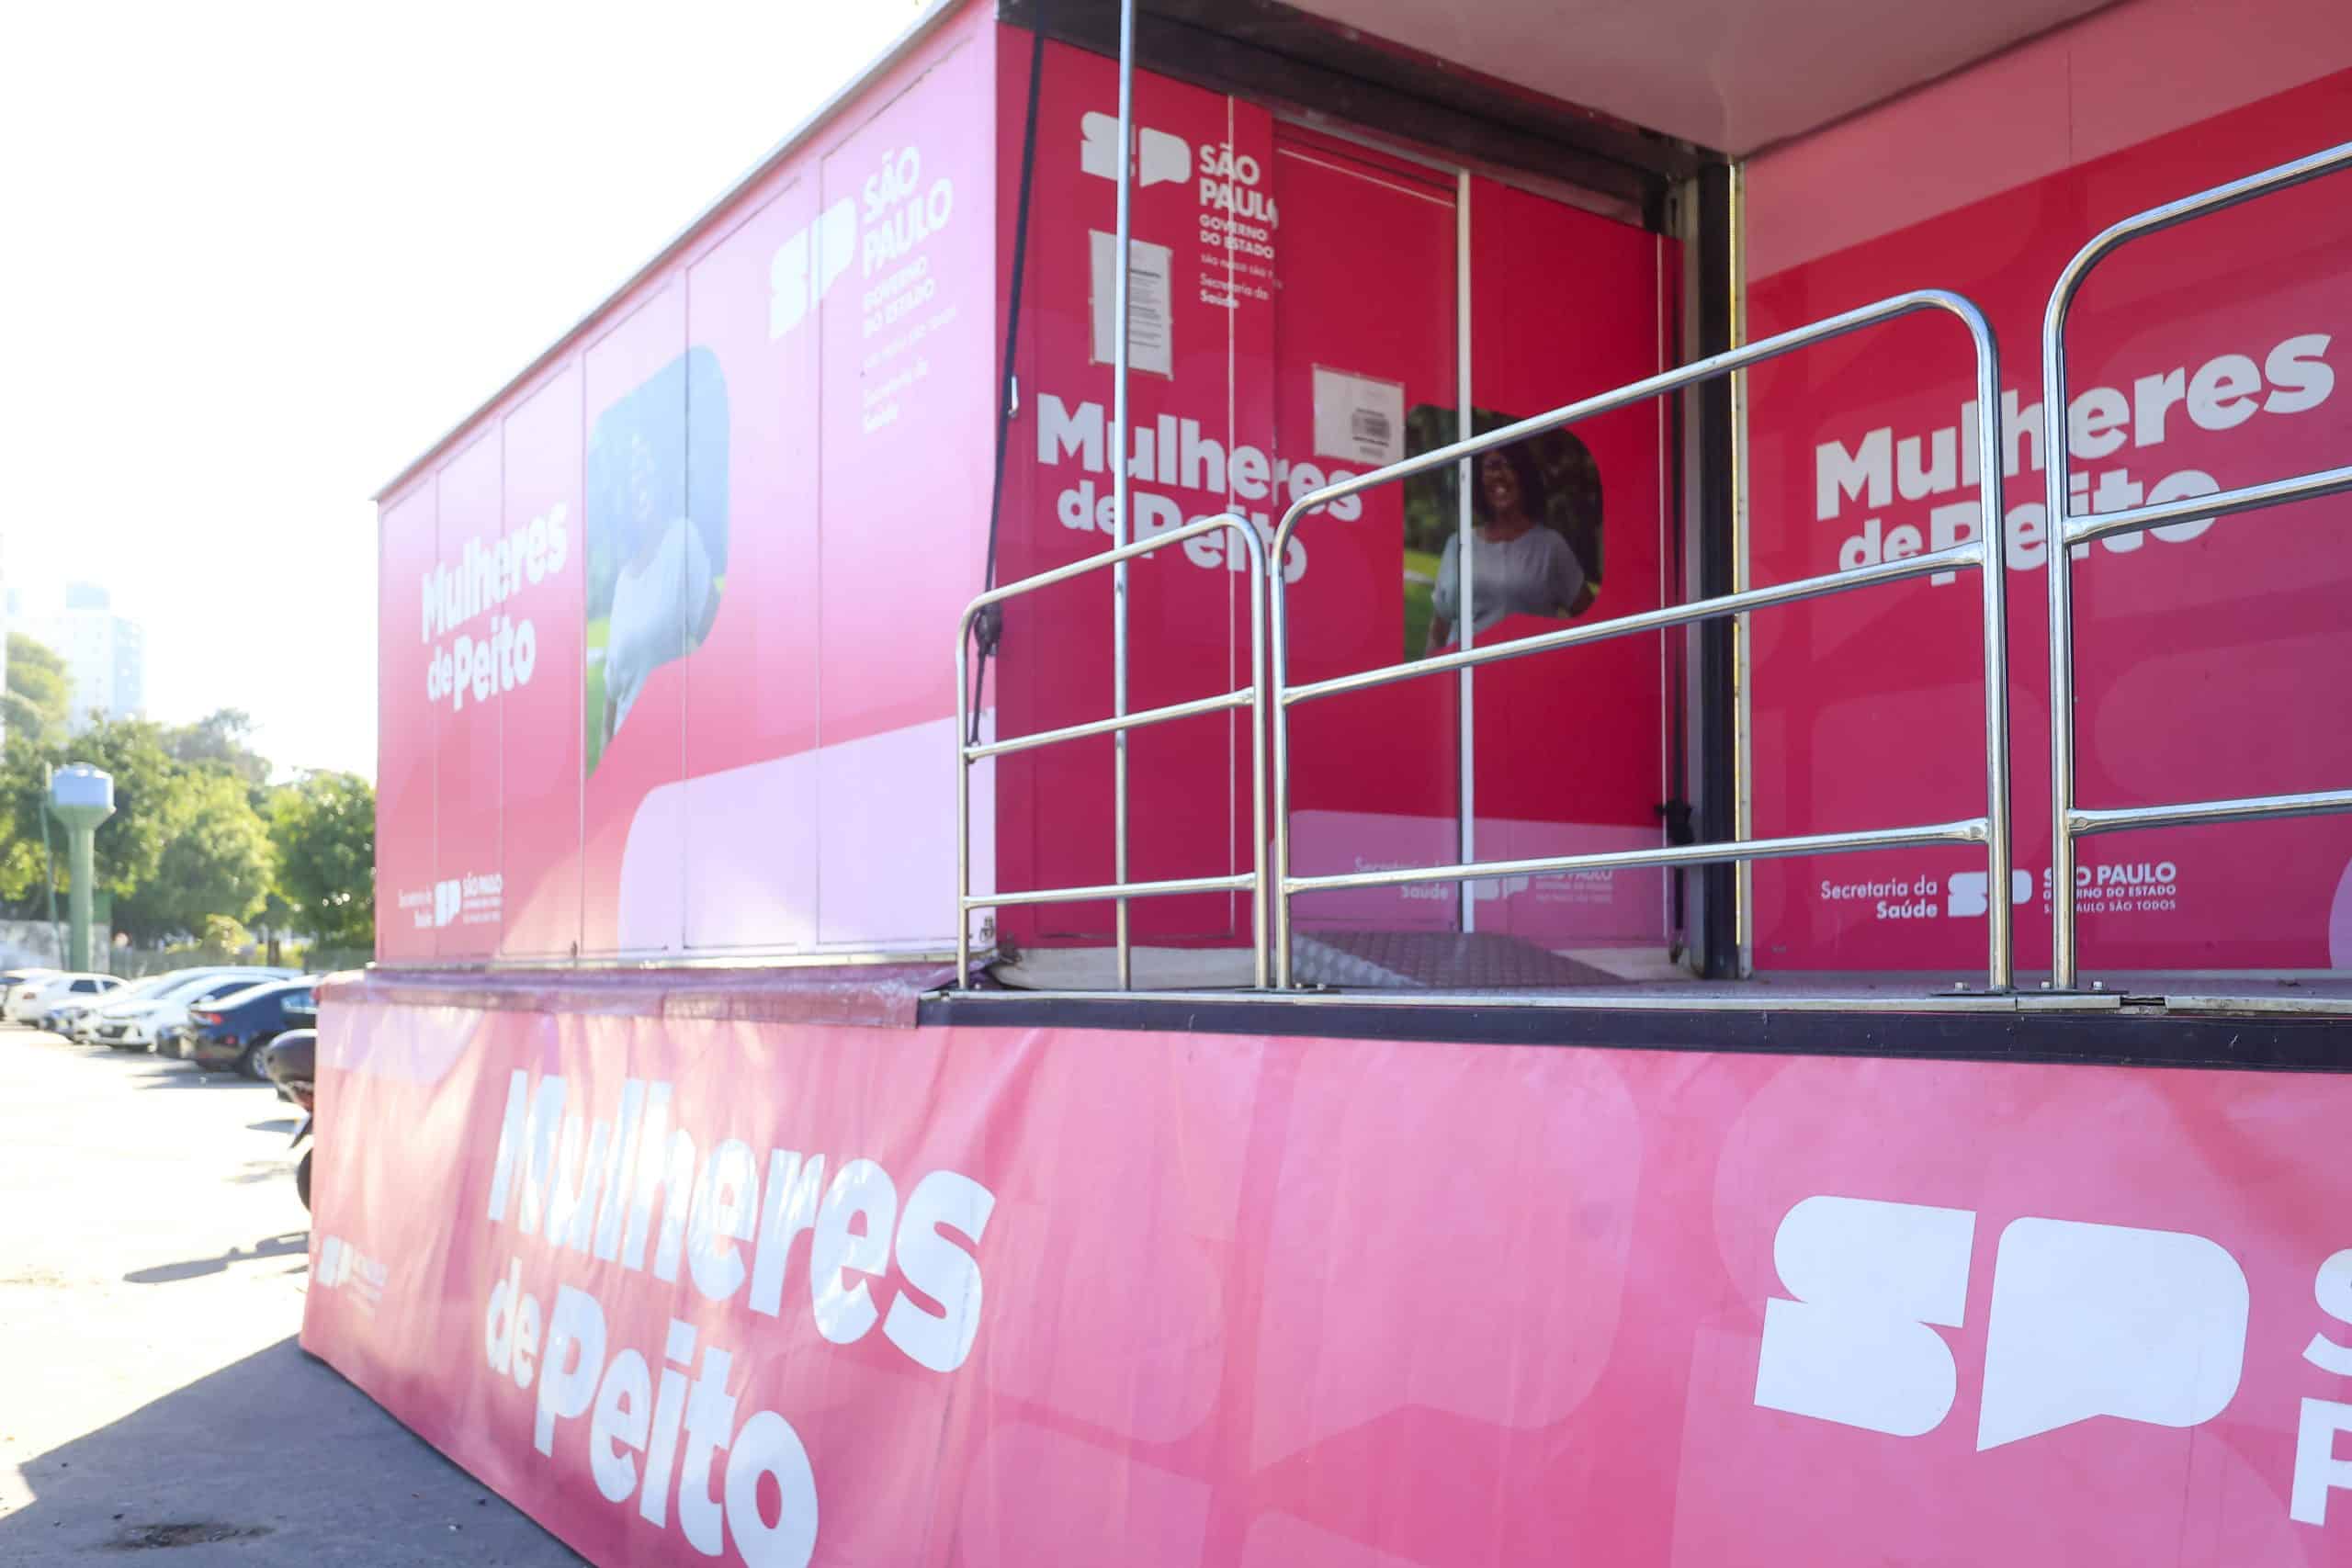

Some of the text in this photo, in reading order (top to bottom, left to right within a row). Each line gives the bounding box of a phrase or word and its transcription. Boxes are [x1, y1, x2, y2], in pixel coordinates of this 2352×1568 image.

[1199, 141, 1261, 186] SÃO
[864, 177, 954, 279] PAULO
[1200, 230, 1275, 260] DO ESTADO
[1814, 333, 2335, 522] Mulheres
[1037, 393, 1363, 522] Mulheres
[1057, 480, 1116, 536] de
[1838, 519, 1923, 571] de
[422, 502, 567, 644] Mulheres
[427, 615, 537, 712] de Peito
[1821, 874, 1938, 898] Secretaria da
[2043, 862, 2177, 888] SO PAULO
[2107, 886, 2124, 897] DO
[2128, 884, 2177, 897] ESTADO
[1876, 899, 1938, 919] Saúde
[2137, 898, 2177, 911] TODOS
[488, 1069, 995, 1372] Mulheres
[485, 1257, 540, 1389] de
[534, 1283, 820, 1568] Peito
